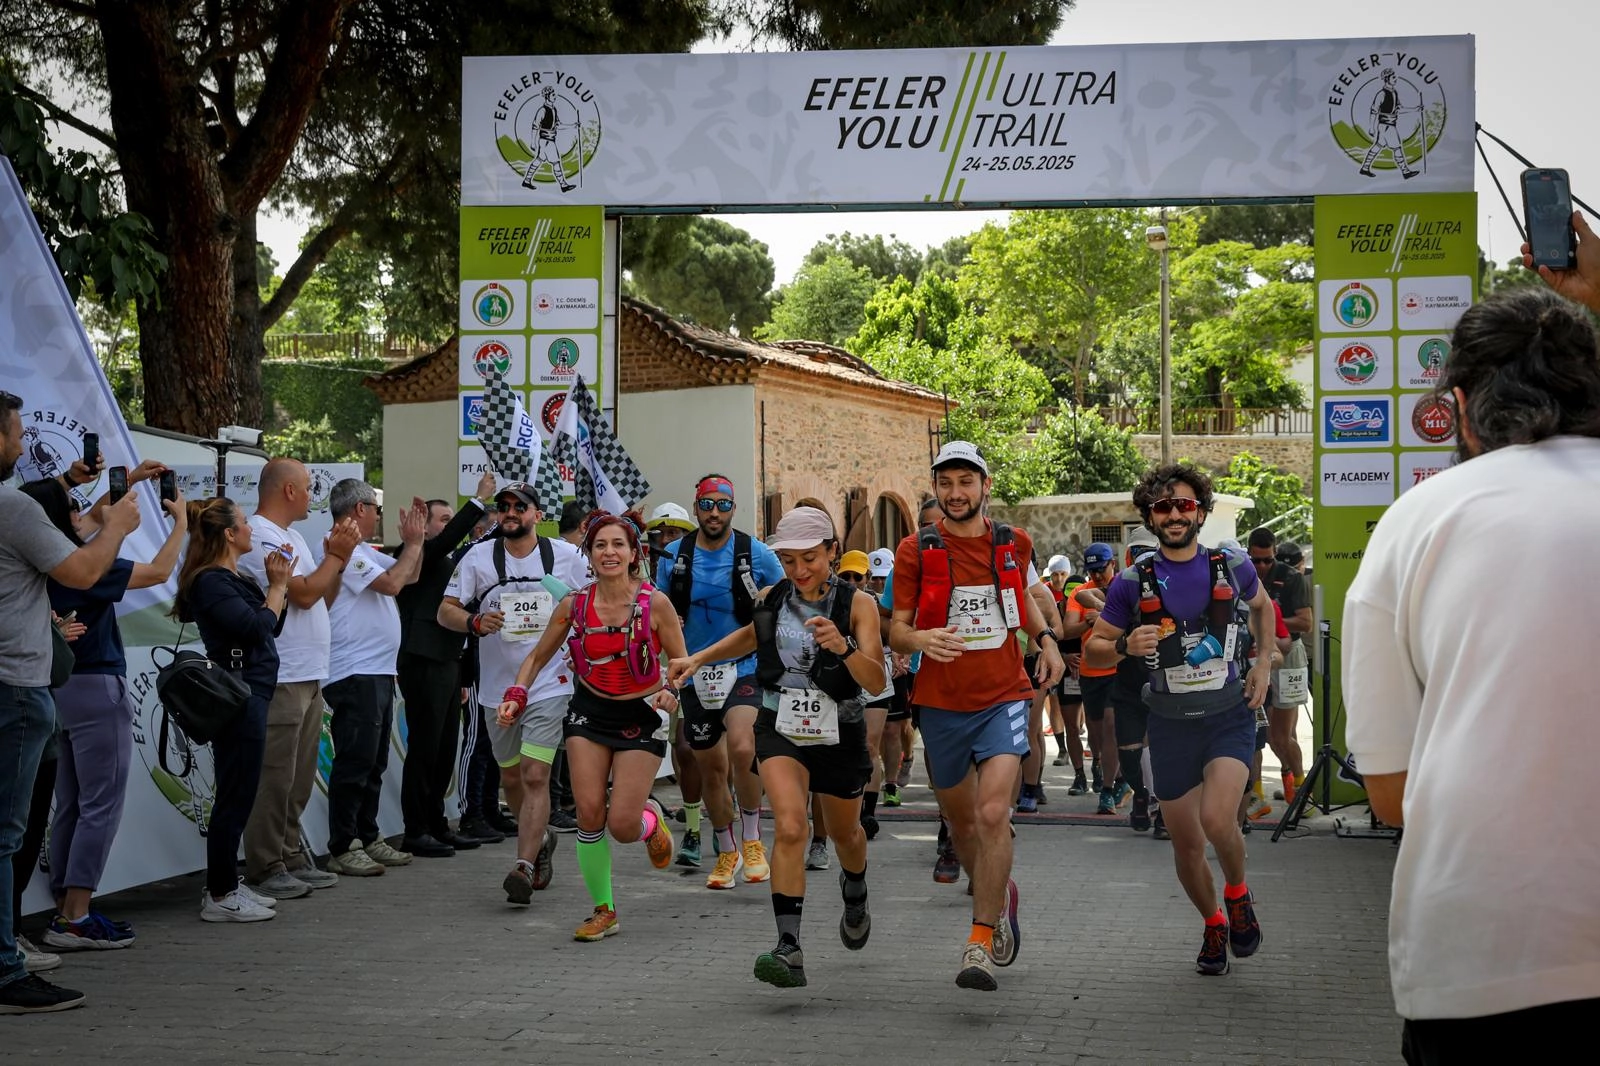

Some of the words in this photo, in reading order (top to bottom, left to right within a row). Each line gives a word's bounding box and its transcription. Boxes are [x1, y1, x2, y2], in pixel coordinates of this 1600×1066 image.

[1329, 54, 1381, 107] EFELER
[1397, 52, 1438, 86] YOLU
[494, 71, 542, 121] EFELER
[555, 71, 594, 103] YOLU
[804, 76, 946, 111] EFELER
[1003, 70, 1117, 106] ULTRA
[836, 115, 938, 151] YOLU
[972, 113, 1069, 147] TRAIL
[962, 154, 1076, 172] 24-25.05.2025
[478, 227, 530, 241] EFELER
[549, 225, 591, 240] ULTRA
[1337, 223, 1394, 239] EFELER
[1415, 220, 1462, 236] ULTRA
[489, 241, 527, 255] YOLU
[539, 241, 573, 255] TRAIL
[1350, 238, 1391, 253] YOLU
[1405, 237, 1442, 251] TRAIL
[514, 601, 538, 612] 204
[960, 597, 988, 611] 251
[701, 670, 724, 681] 202
[791, 699, 821, 713] 216
